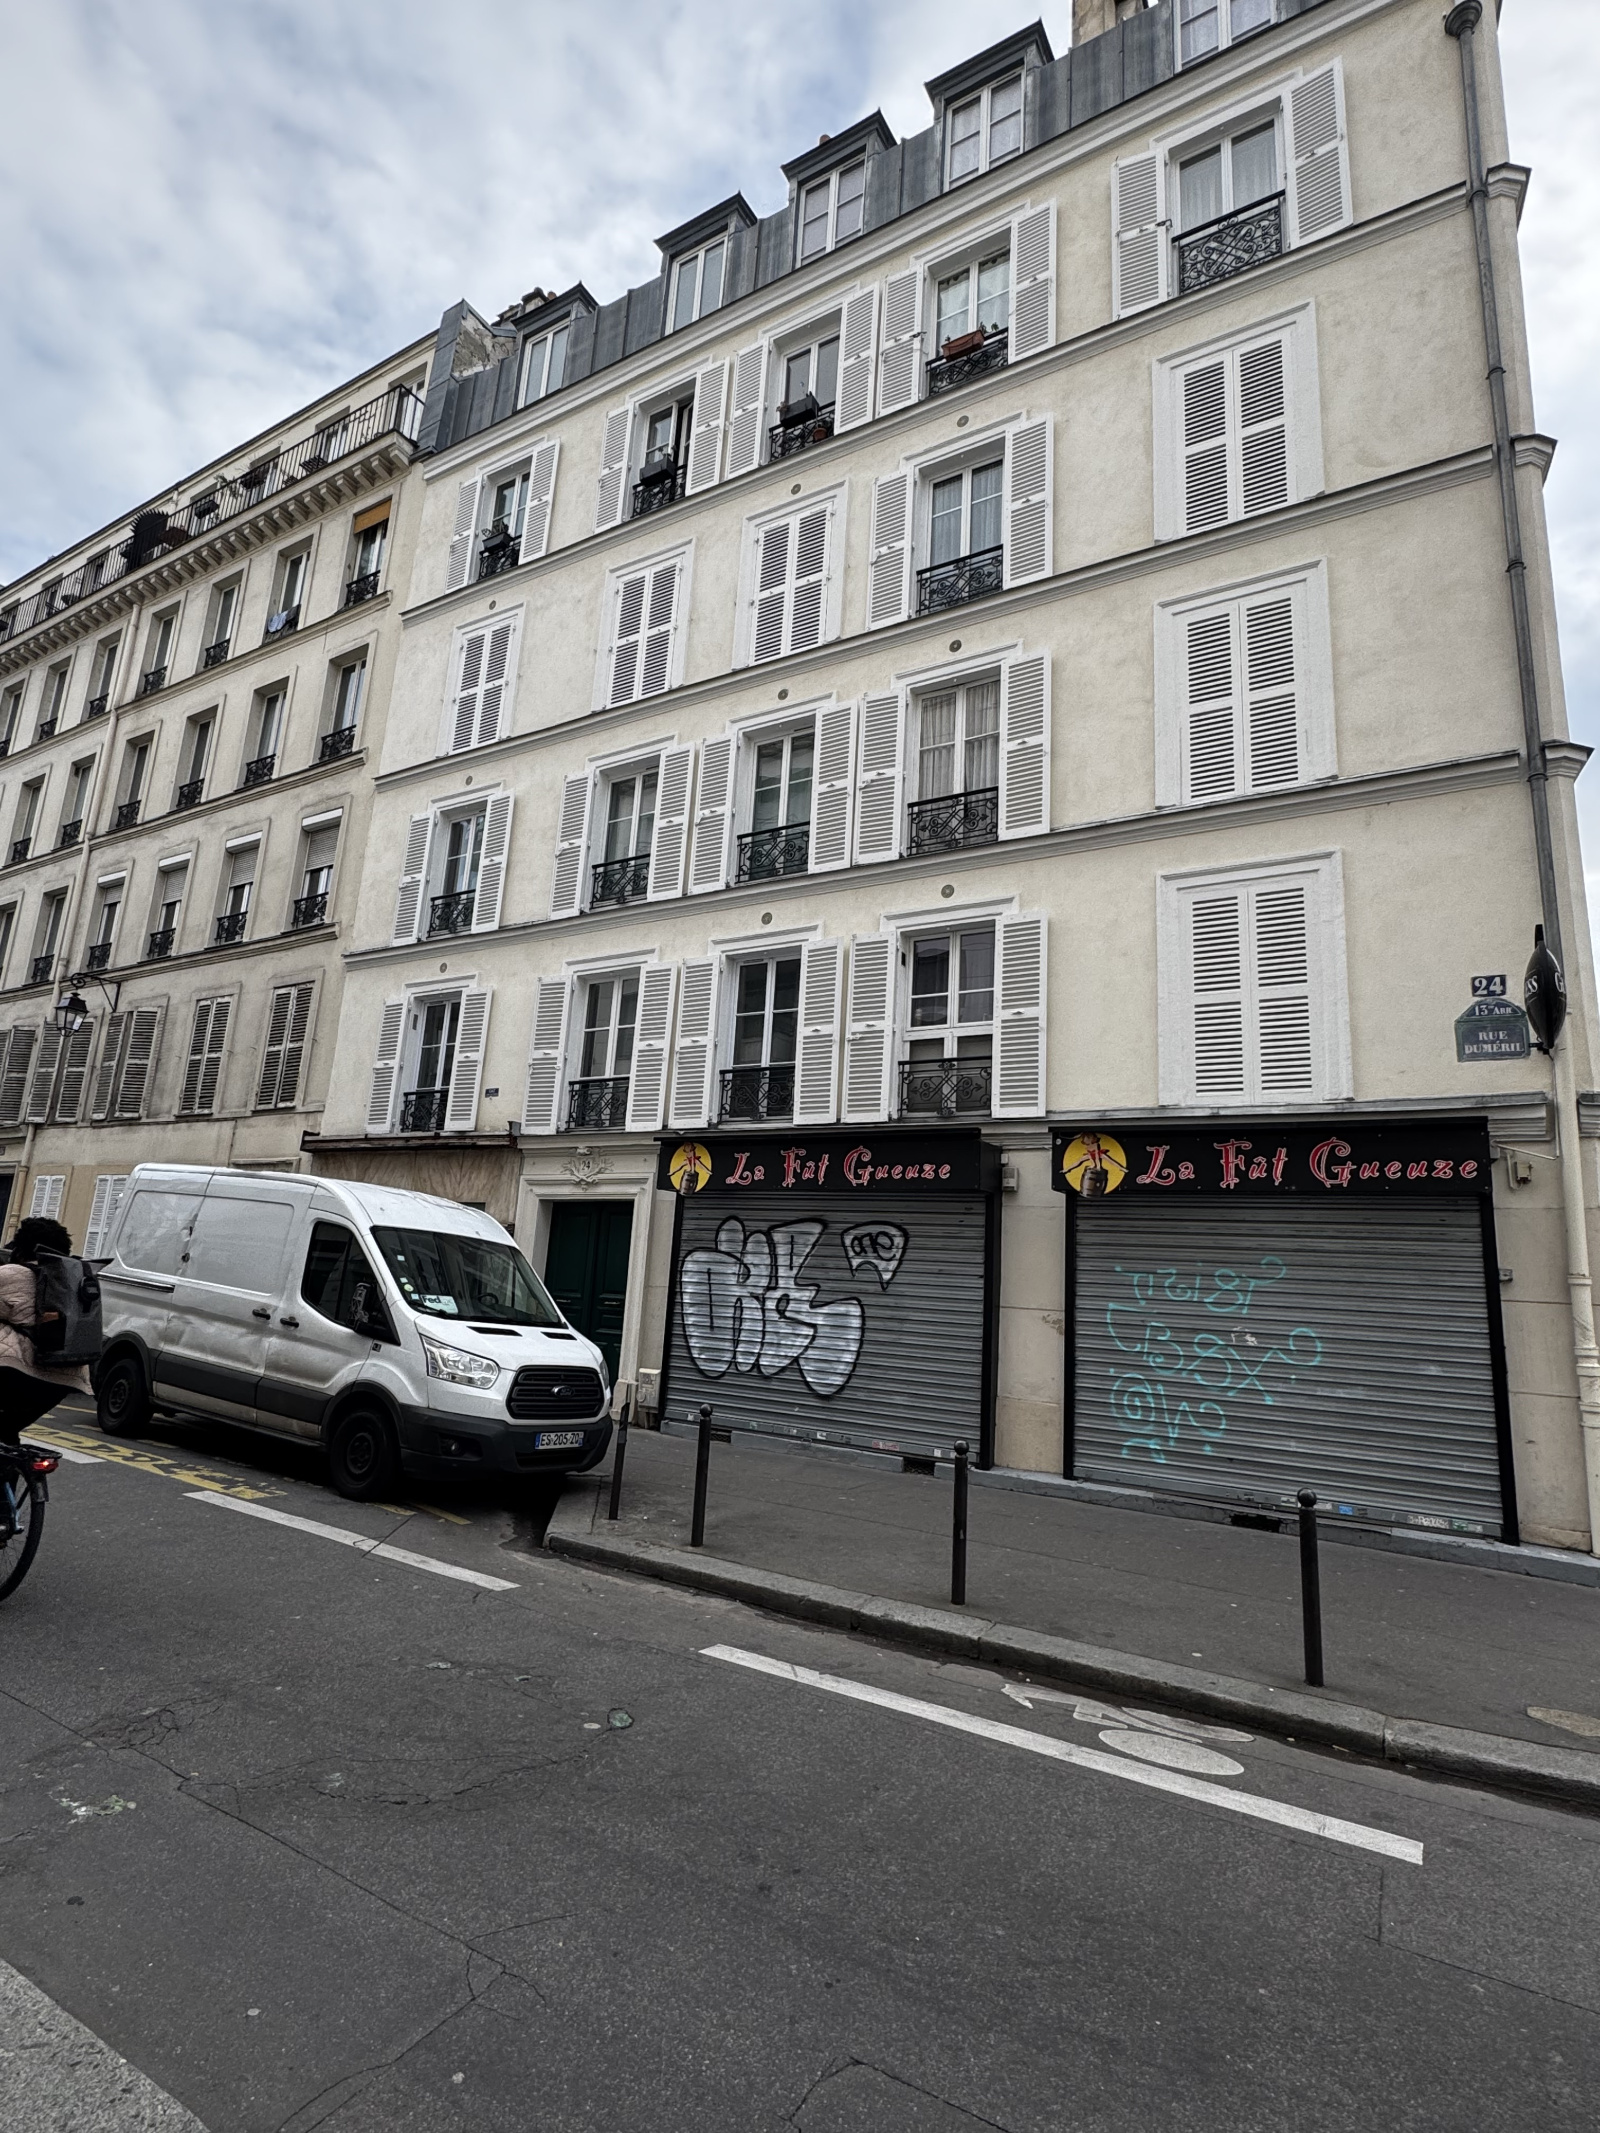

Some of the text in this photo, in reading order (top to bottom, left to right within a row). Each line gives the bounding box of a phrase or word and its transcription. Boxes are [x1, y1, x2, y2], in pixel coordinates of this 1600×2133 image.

[1473, 976, 1504, 996] 24
[1478, 1030, 1508, 1041] RUE
[1464, 1040, 1524, 1055] DUMÉRIL
[581, 1160, 591, 1171] 24
[726, 1146, 951, 1188] La Fût Gueuze
[1136, 1137, 1479, 1189] La Fût Gueuze
